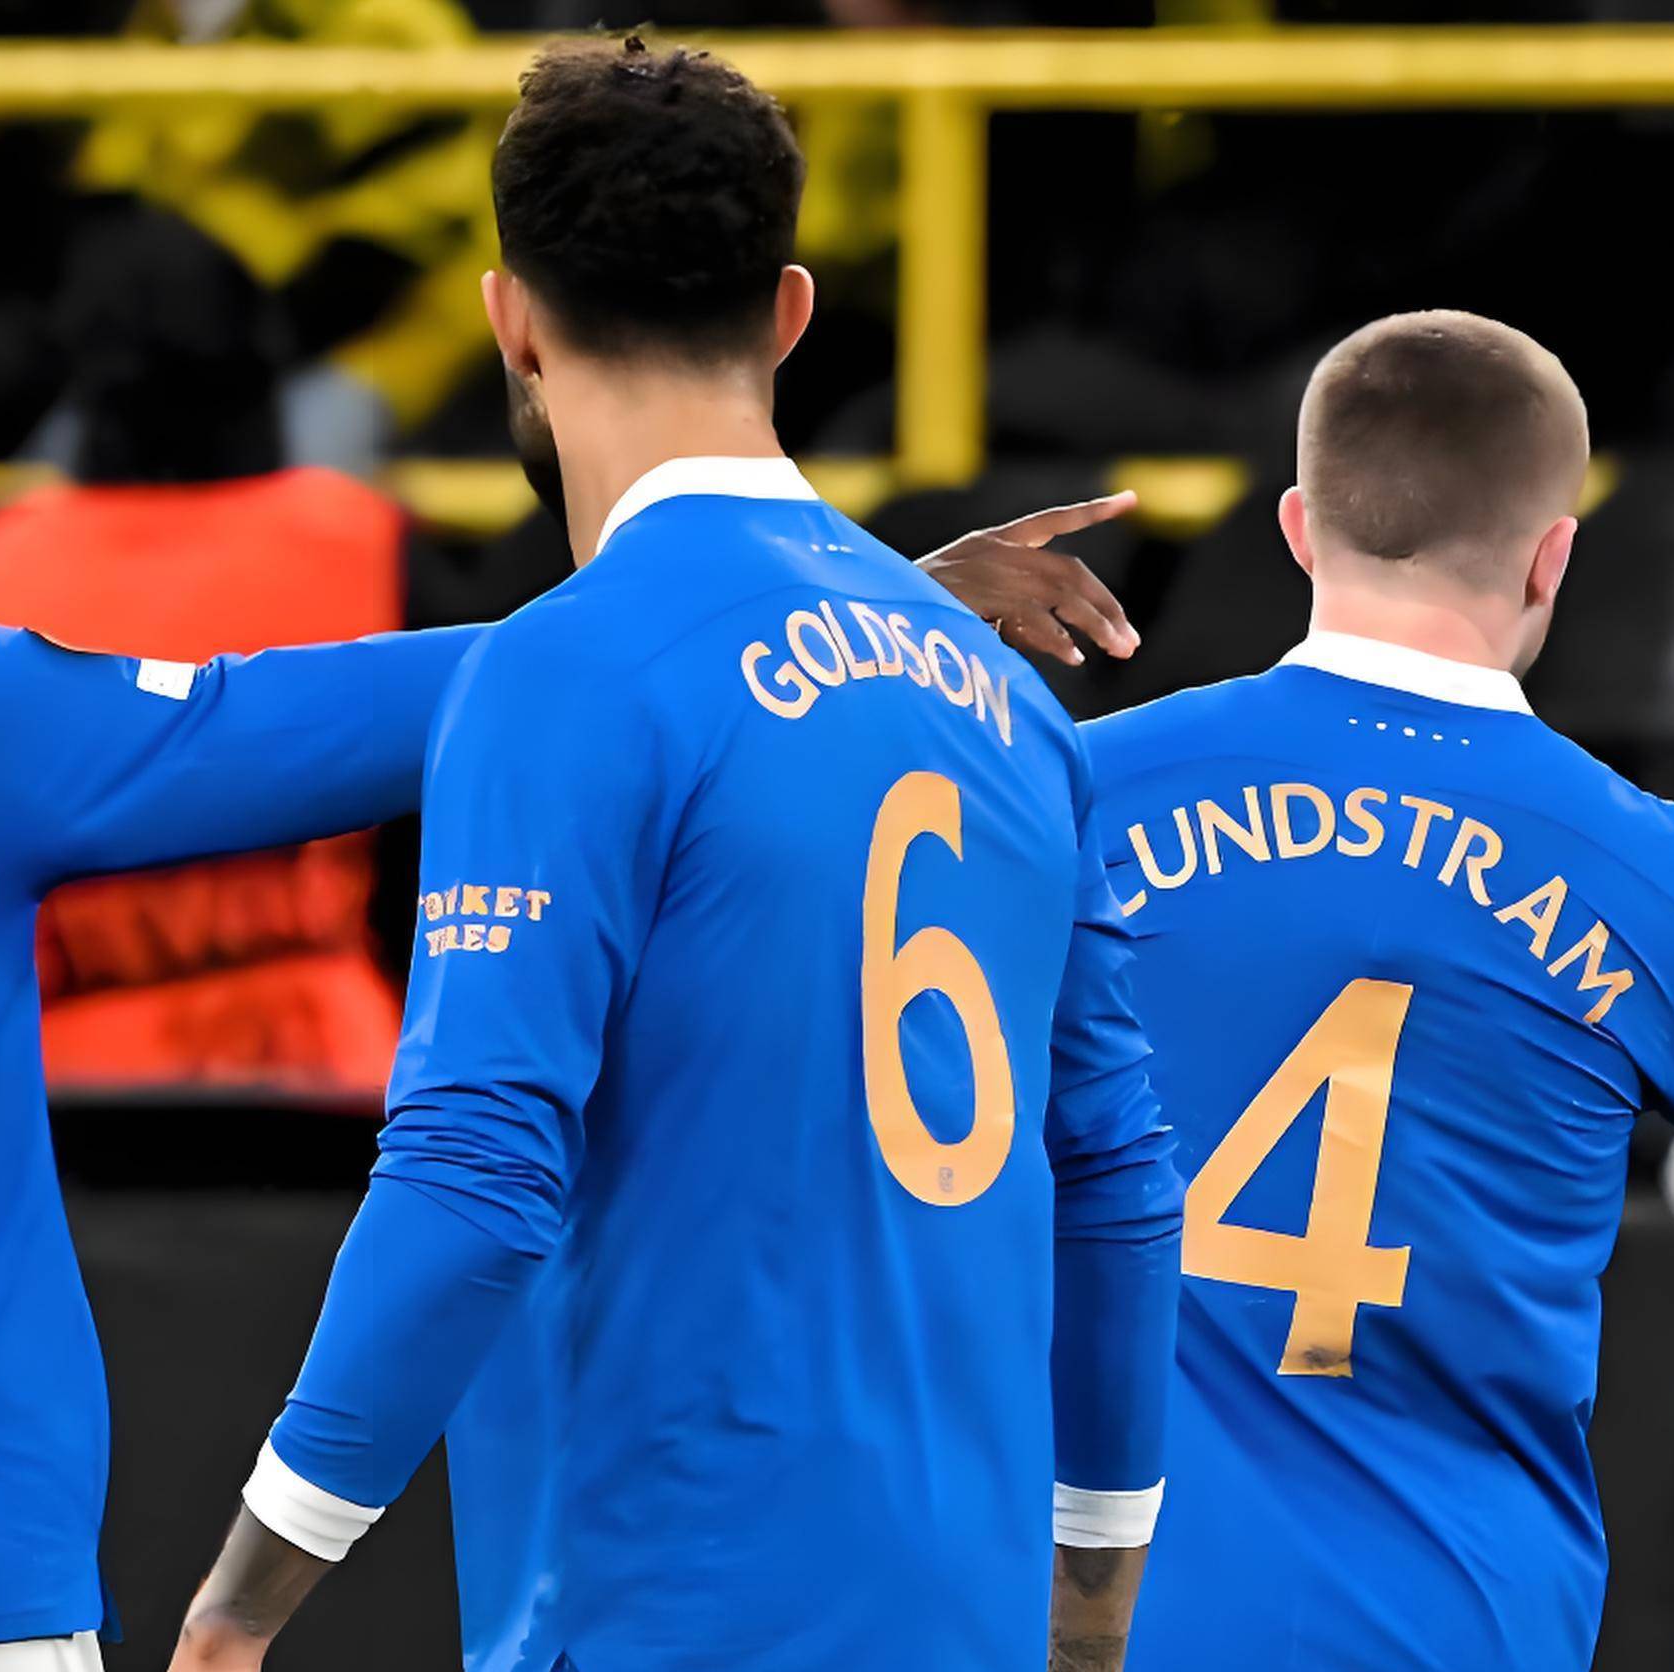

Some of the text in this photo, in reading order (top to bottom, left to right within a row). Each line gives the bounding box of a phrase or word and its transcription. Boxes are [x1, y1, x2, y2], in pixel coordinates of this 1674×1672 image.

[741, 600, 1013, 746] GOLDSON
[861, 770, 1016, 1207] 6
[1180, 977, 1414, 1377] 4
